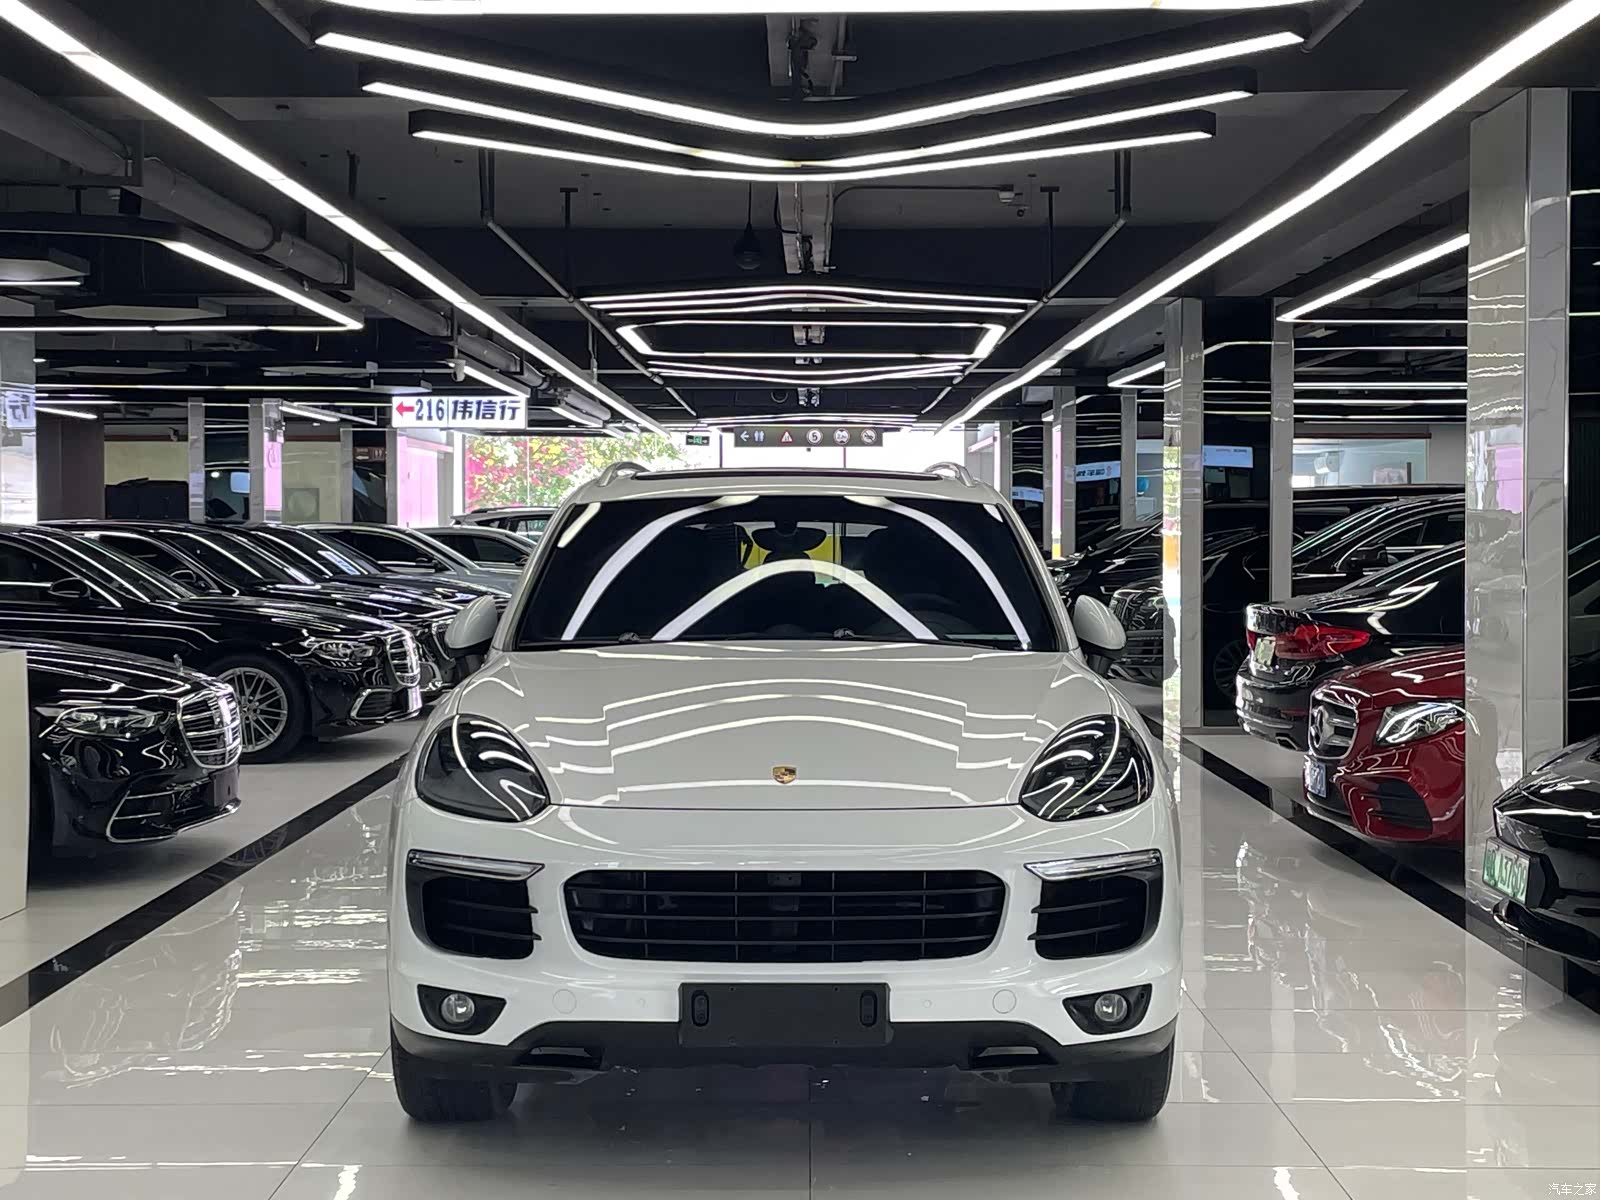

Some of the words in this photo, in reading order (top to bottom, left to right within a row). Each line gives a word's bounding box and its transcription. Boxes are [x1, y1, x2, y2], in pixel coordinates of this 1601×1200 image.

[415, 399, 444, 421] 216
[452, 399, 521, 420] 伟信行
[812, 432, 818, 441] 5
